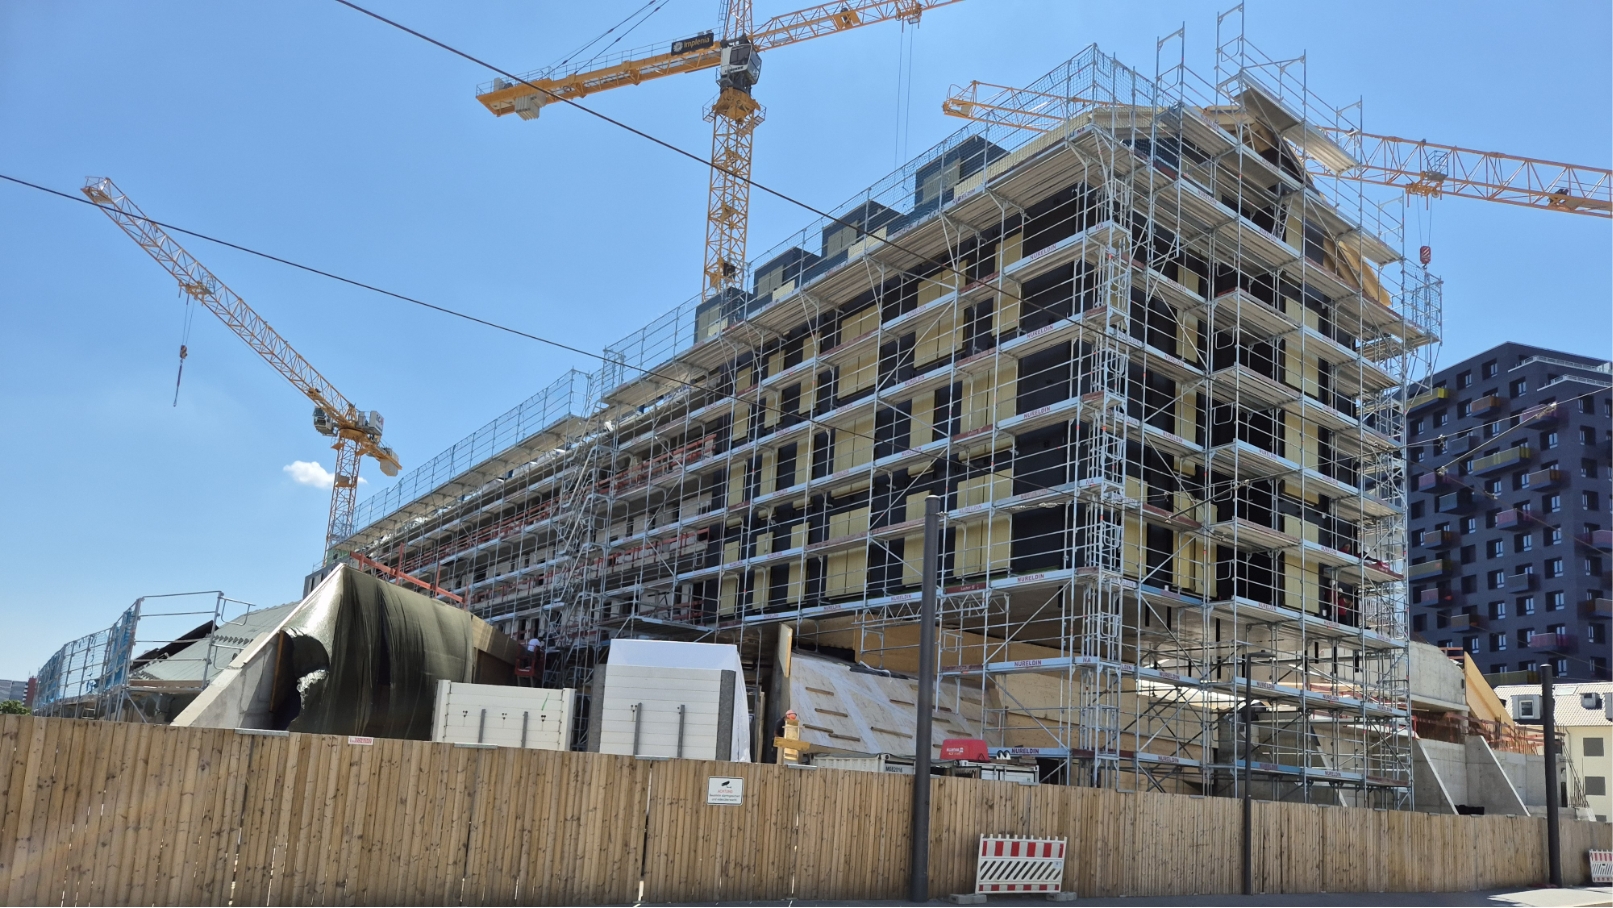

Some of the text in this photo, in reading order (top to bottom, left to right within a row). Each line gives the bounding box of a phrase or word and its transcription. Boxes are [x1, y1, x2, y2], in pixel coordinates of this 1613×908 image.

[1030, 244, 1057, 260] NURELDIN
[1027, 324, 1054, 339] NURELDIN
[1023, 406, 1051, 419] NURELDIN
[1017, 573, 1045, 582] NURELDIN
[1014, 659, 1042, 668] NURELDIN
[1159, 671, 1180, 680] NURELDIN
